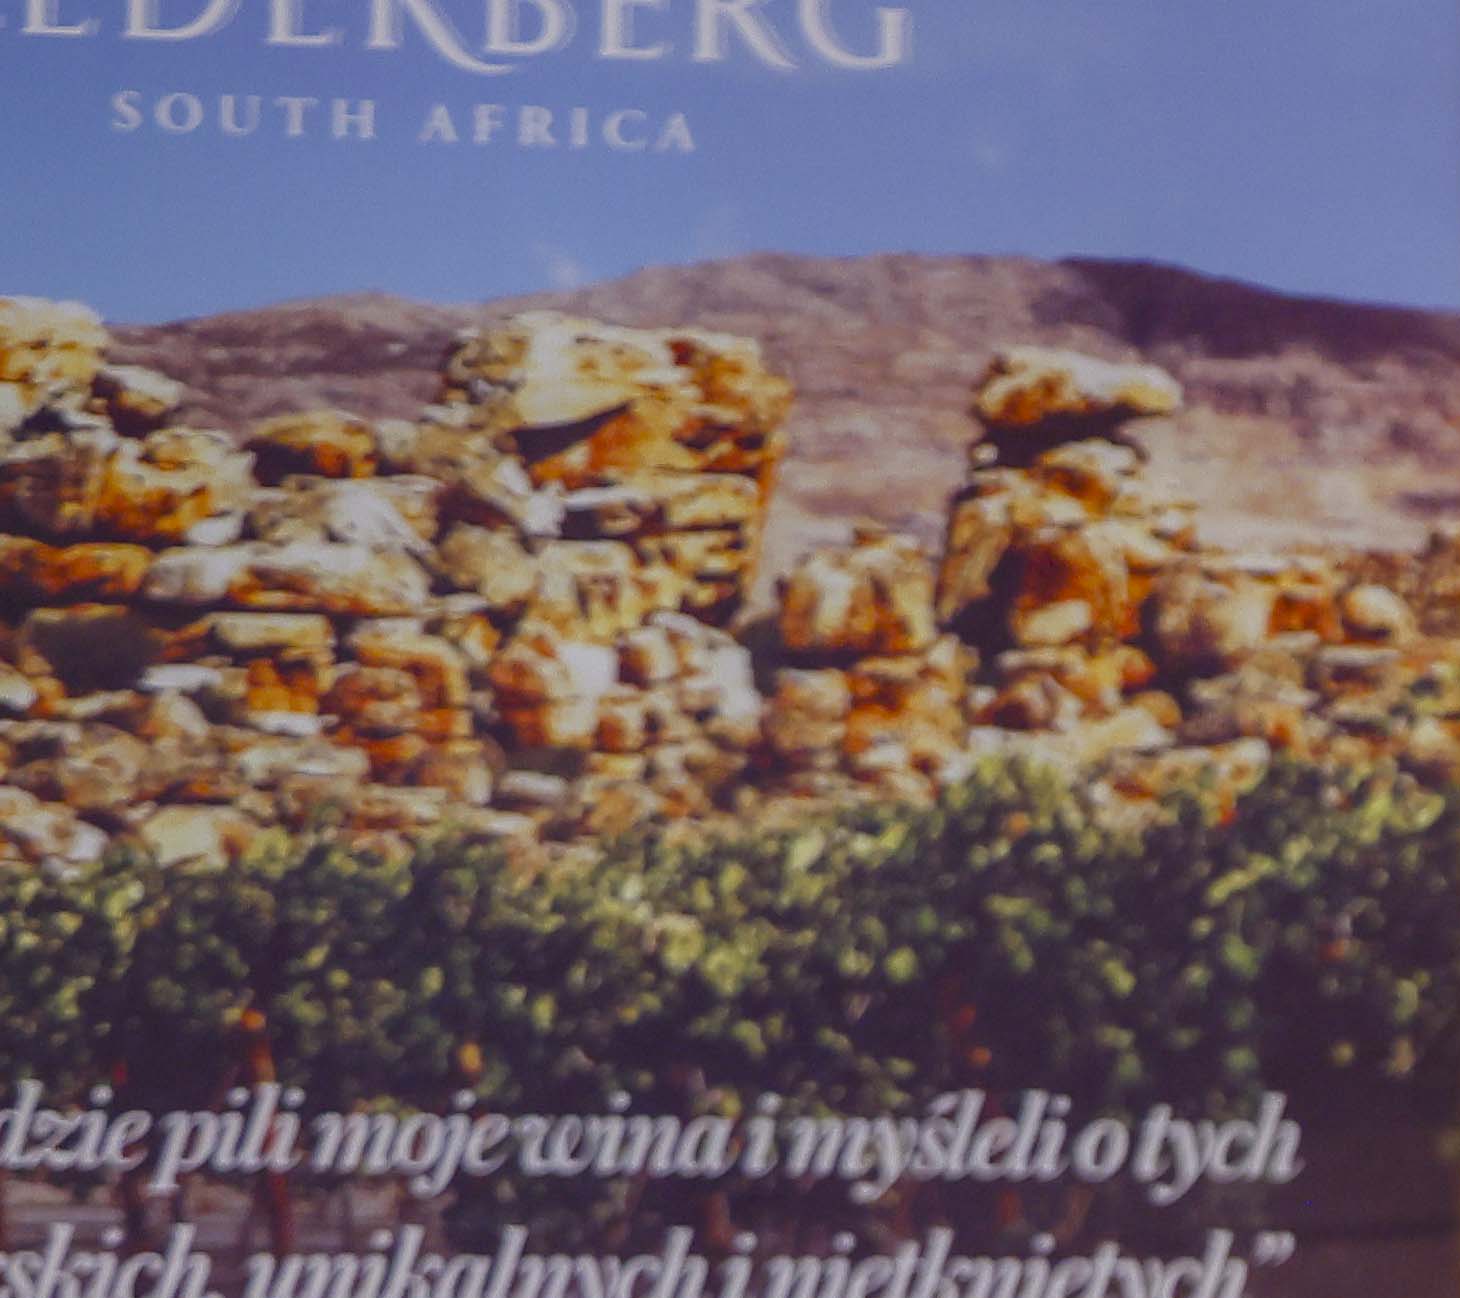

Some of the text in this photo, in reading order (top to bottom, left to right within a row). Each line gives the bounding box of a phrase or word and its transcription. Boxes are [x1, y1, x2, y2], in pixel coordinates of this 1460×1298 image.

[110, 90, 697, 153] SOUTH AFRICA
[0, 1078, 1305, 1207] dzie pili moje wina i myśleli o tych
